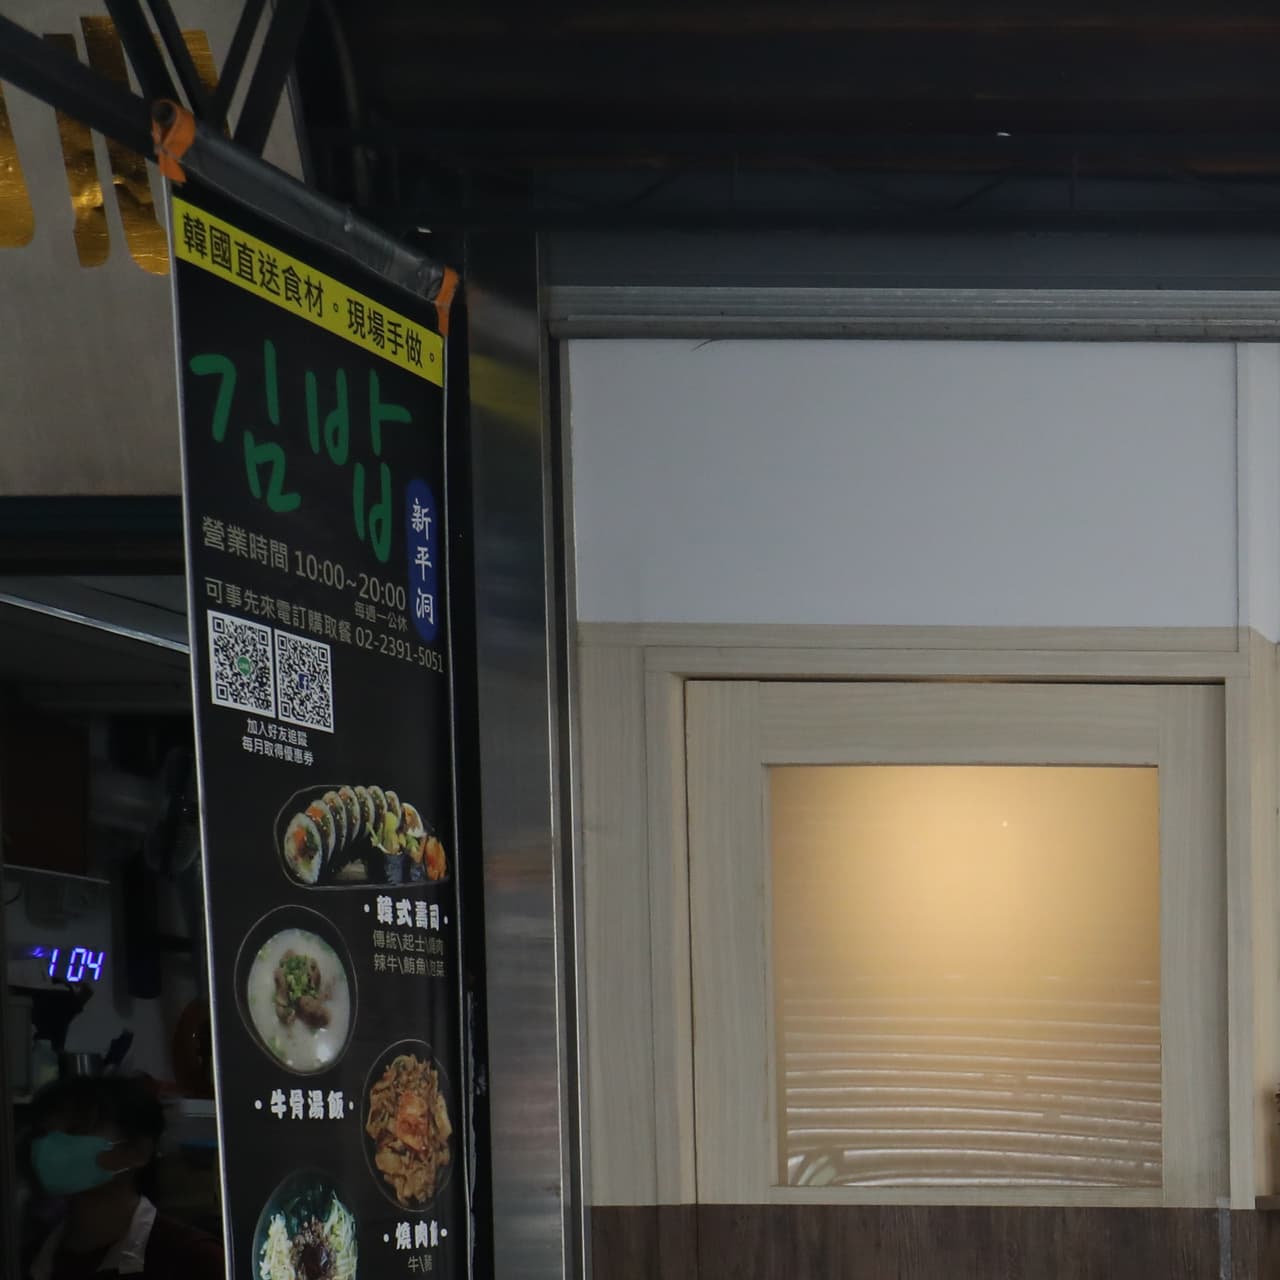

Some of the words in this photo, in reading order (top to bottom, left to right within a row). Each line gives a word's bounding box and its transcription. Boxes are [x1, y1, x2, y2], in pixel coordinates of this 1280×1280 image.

[190, 339, 412, 562] 김밥
[202, 515, 289, 573] 營業時間
[411, 498, 434, 625] 新平洞
[204, 576, 352, 645] 可事先來電訂購取餐
[355, 627, 445, 674] 02-2391-5051
[376, 895, 440, 931] 韓式壽司
[270, 1088, 344, 1121] 牛骨湯飯
